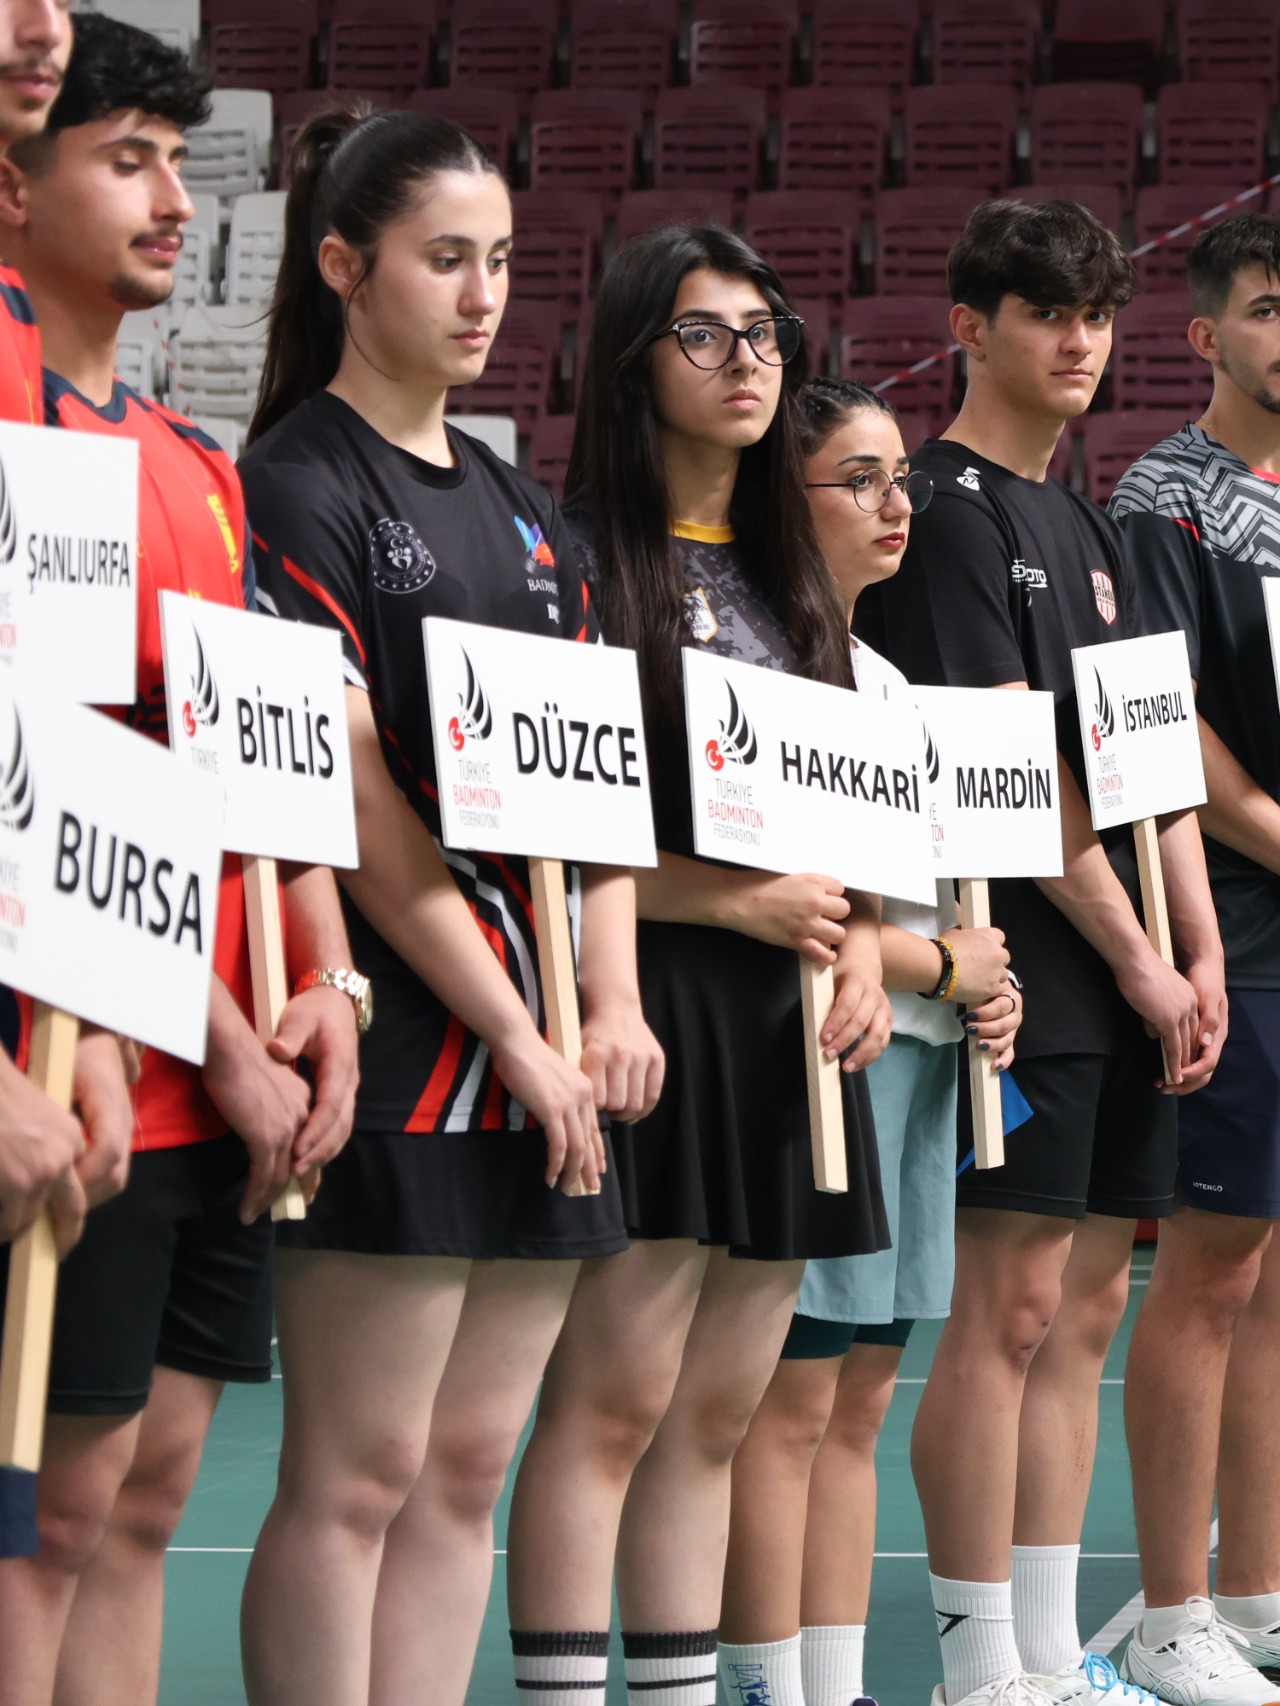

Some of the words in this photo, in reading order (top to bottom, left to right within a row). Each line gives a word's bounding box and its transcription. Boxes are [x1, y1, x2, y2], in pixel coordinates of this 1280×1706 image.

[27, 534, 131, 595] ŞANLIURFA
[236, 684, 334, 780] BİTLİS
[512, 701, 641, 788] DÜZCE
[1122, 691, 1188, 733] İSTANBUL
[714, 777, 754, 805] TÜRKİYE
[780, 740, 920, 814] HAKKARİ
[956, 758, 1052, 810] MARDİN
[54, 810, 203, 955] BURSA
